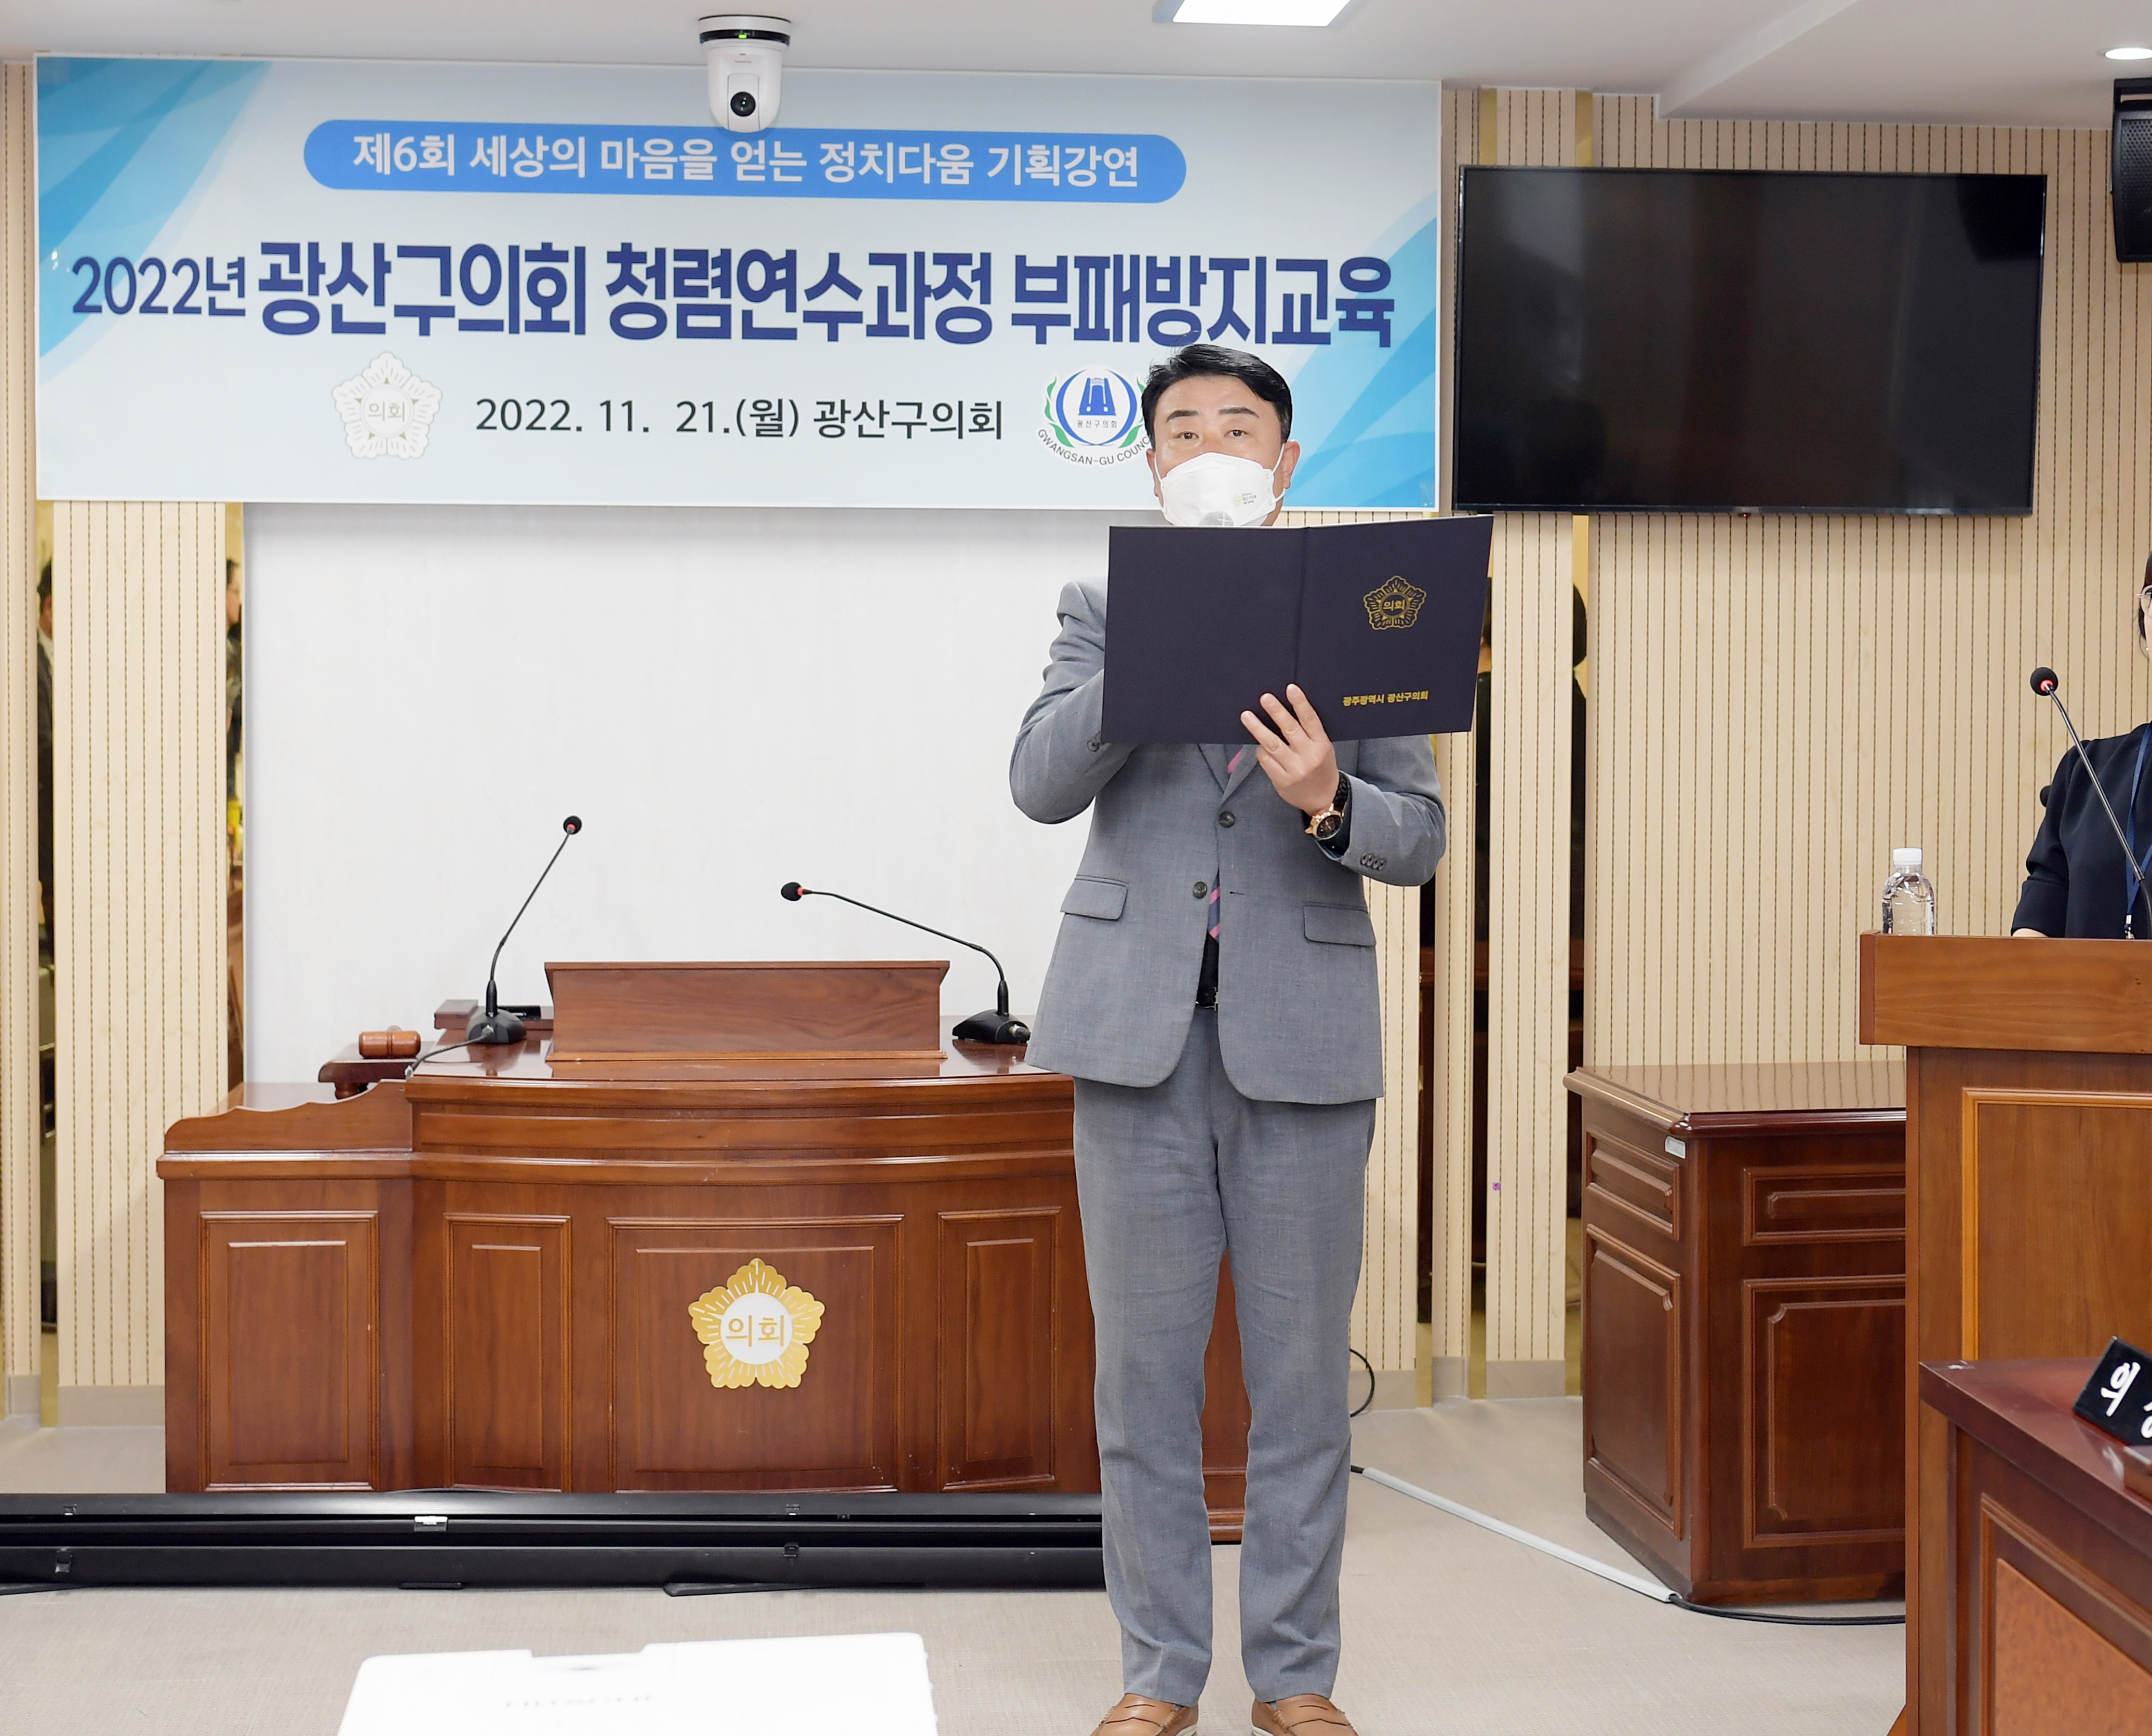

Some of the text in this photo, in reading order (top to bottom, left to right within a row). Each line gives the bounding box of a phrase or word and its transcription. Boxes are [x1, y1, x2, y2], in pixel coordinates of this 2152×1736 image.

[353, 133, 1140, 187] 제6회 세상의 마음을 얻는 정치다움 기획강연
[72, 241, 1395, 348] 2022년 광산구의회 청렴연수과정 부패방지교육
[368, 401, 405, 422] 의회
[476, 398, 1001, 439] 2022. 11. 21.(월) 광산구의회
[1077, 420, 1117, 429] 광산구의회
[1038, 429, 1151, 465] GWANGSAN-GU COUNC
[1383, 599, 1405, 611] 의회
[1343, 690, 1428, 706] 광주광역시 광산구의회
[726, 1315, 784, 1347] 의회
